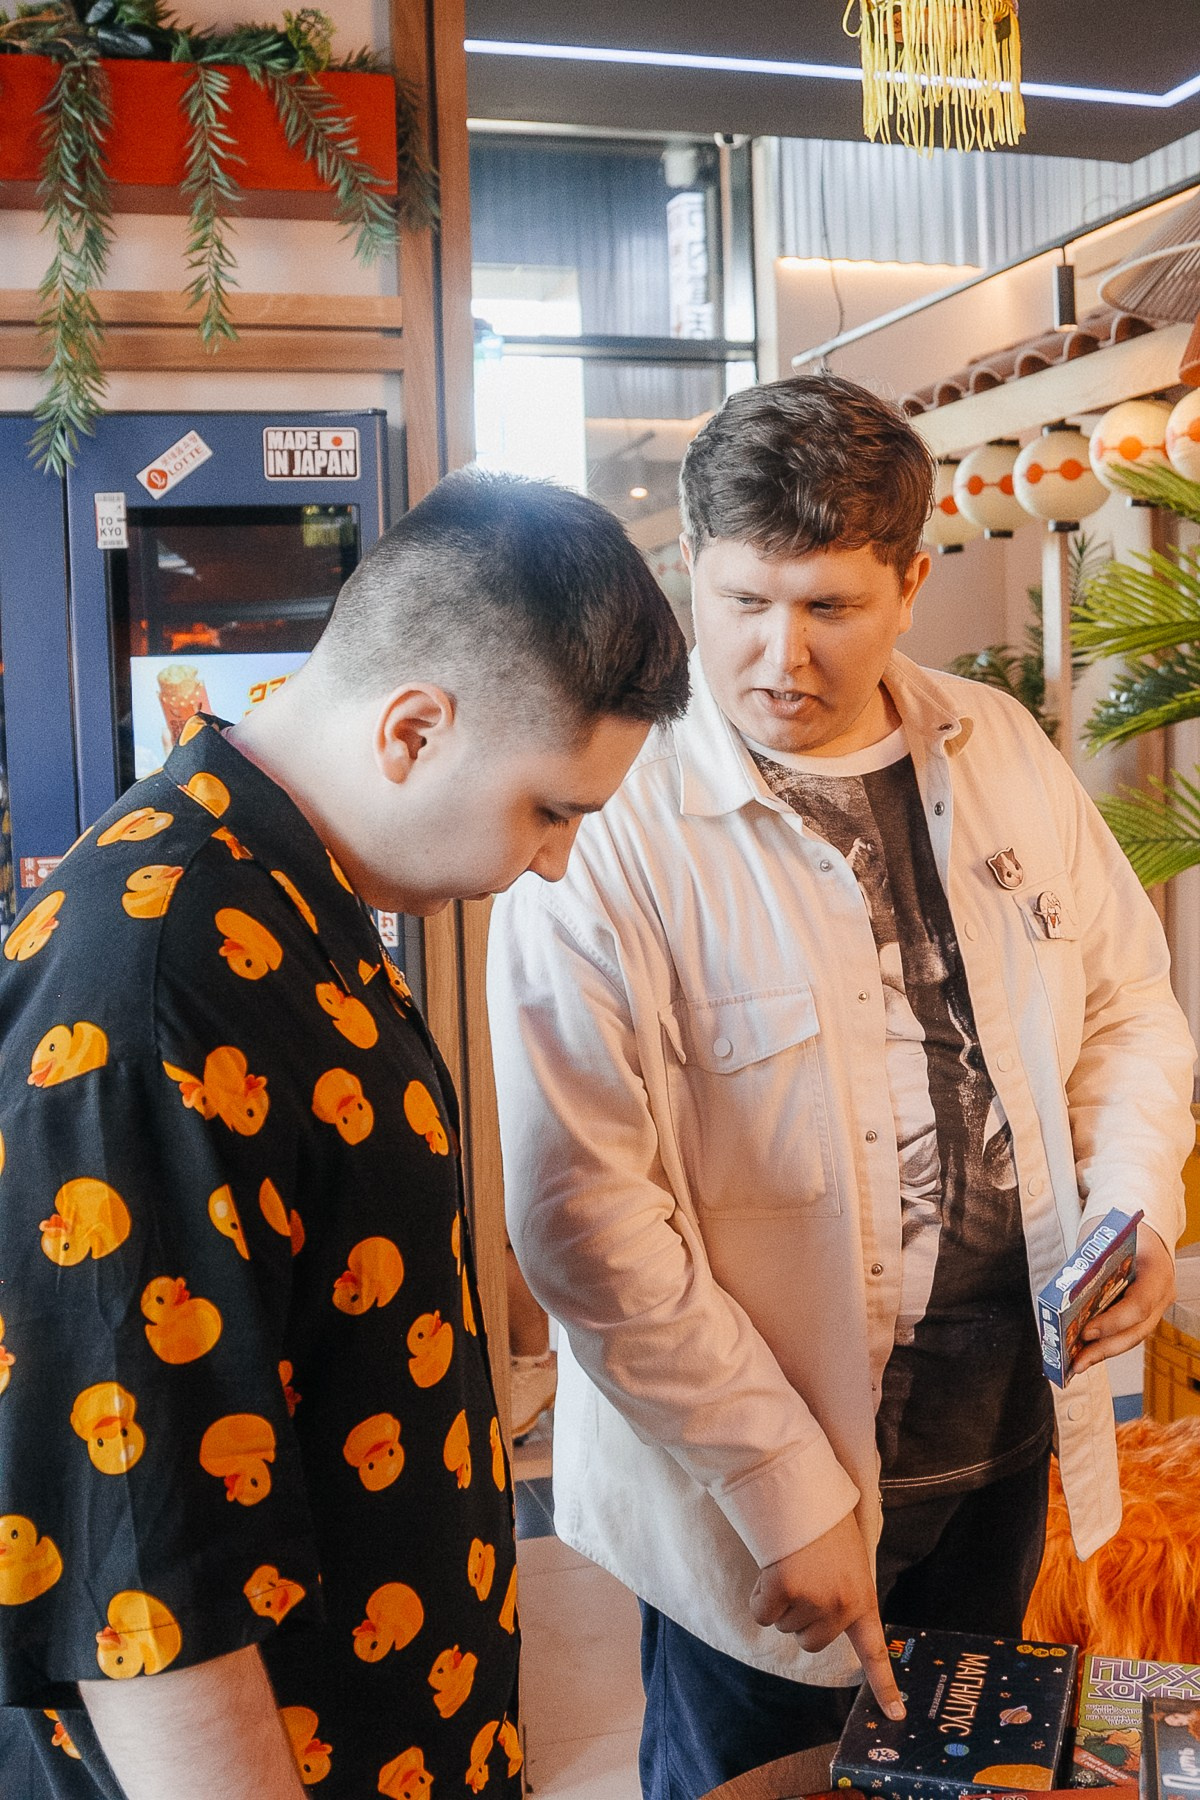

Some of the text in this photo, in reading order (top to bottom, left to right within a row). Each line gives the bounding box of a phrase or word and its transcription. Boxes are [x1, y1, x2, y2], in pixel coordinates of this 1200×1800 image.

[267, 431, 319, 449] MADE
[168, 446, 204, 476] LOTTE
[267, 450, 355, 475] IN JAPAN
[100, 517, 113, 526] TO
[100, 527, 122, 537] KYO
[1081, 1226, 1117, 1263] SIMILO
[939, 1653, 990, 1736] МАГНИТУС
